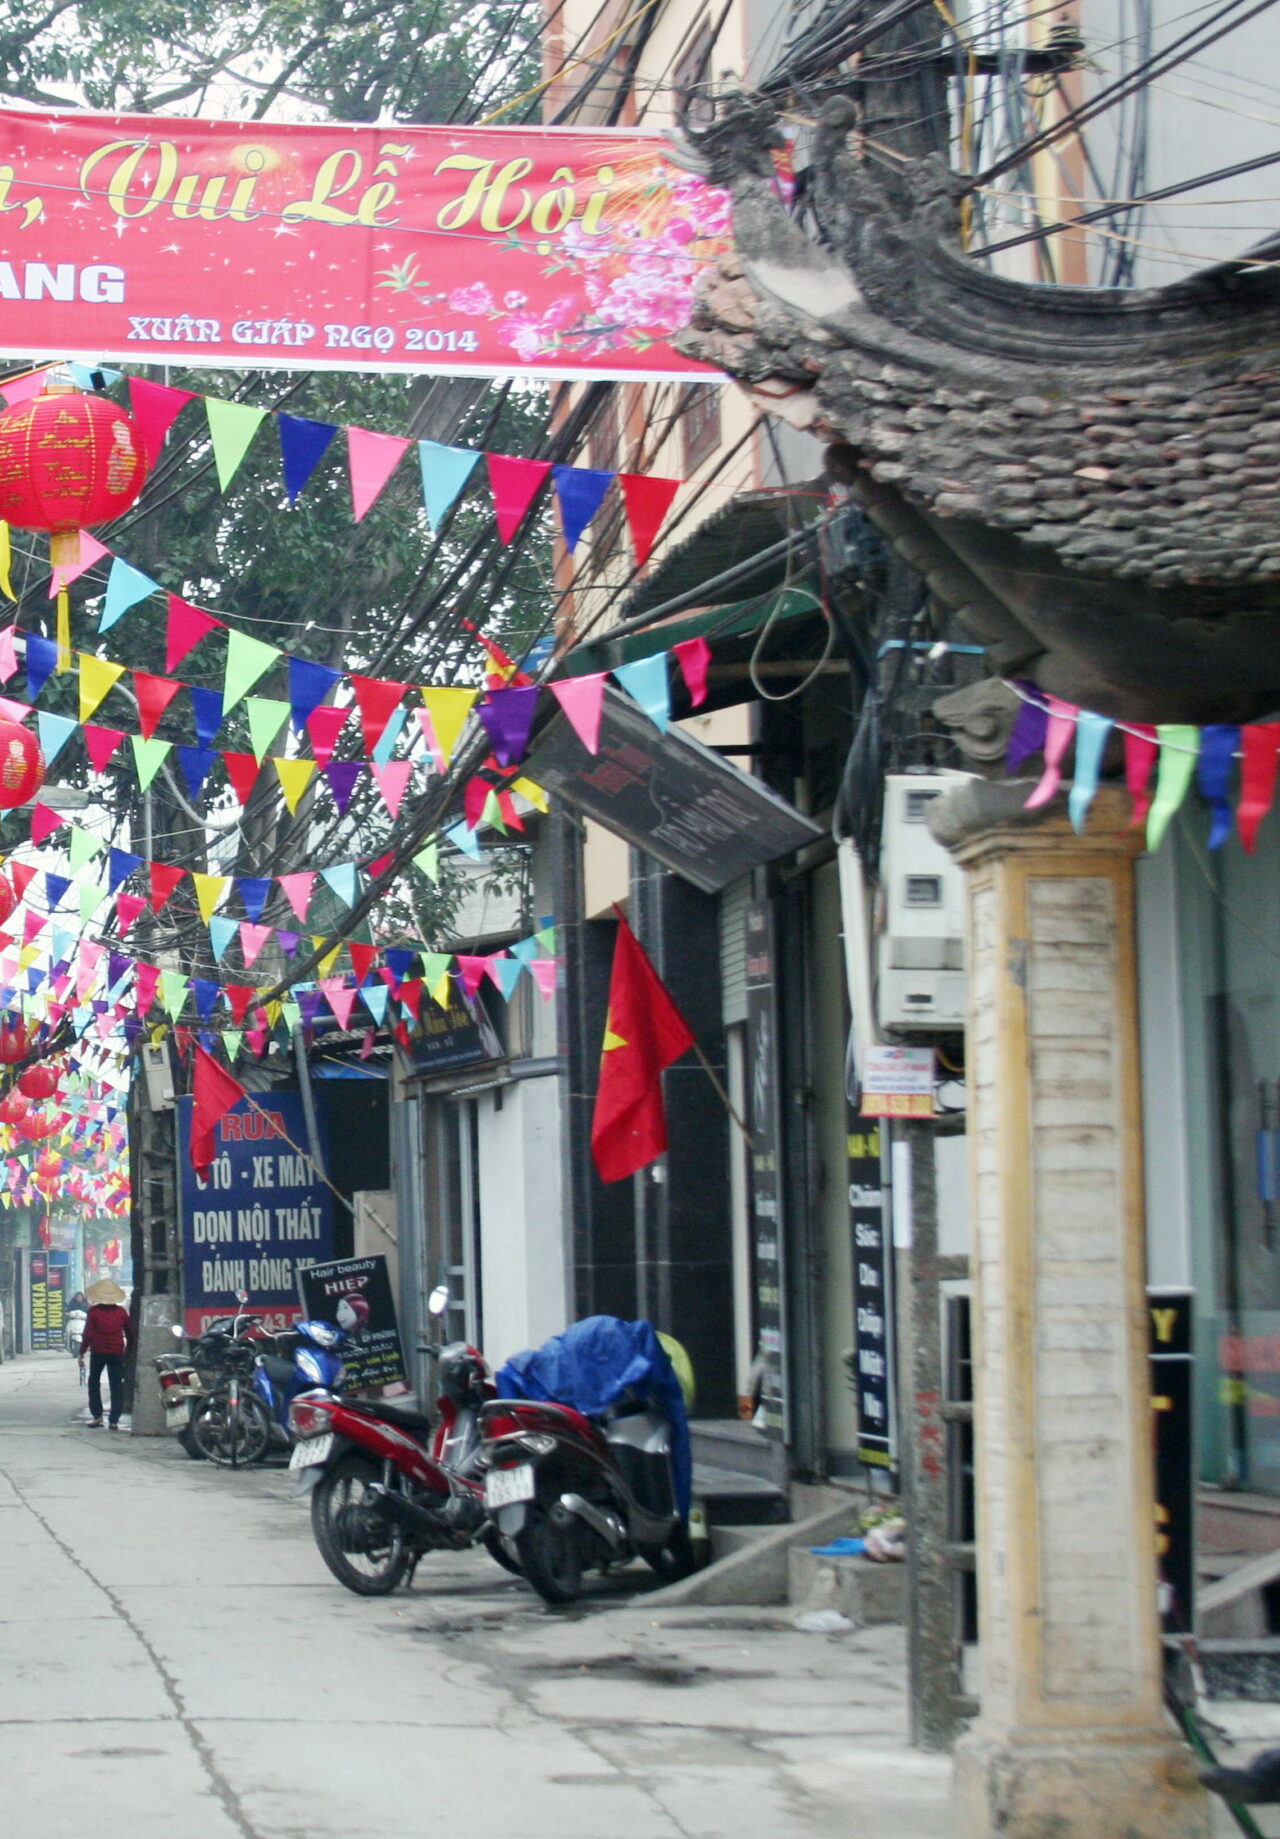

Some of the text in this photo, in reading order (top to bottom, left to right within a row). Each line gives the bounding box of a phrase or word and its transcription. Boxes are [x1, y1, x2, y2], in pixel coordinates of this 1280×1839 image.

[80, 139, 274, 222] Vui
[282, 141, 410, 228] Lễ
[433, 153, 616, 256] Hội
[127, 315, 478, 355] XUÂN GIÁP NGỌ 2014
[252, 1156, 275, 1188] XE
[193, 1195, 322, 1250] DỌN NỘI THẤT
[202, 1252, 293, 1292] ĐÁNH BÓNG
[309, 1258, 377, 1280] Hair beauty
[32, 1281, 47, 1329] NOKIA
